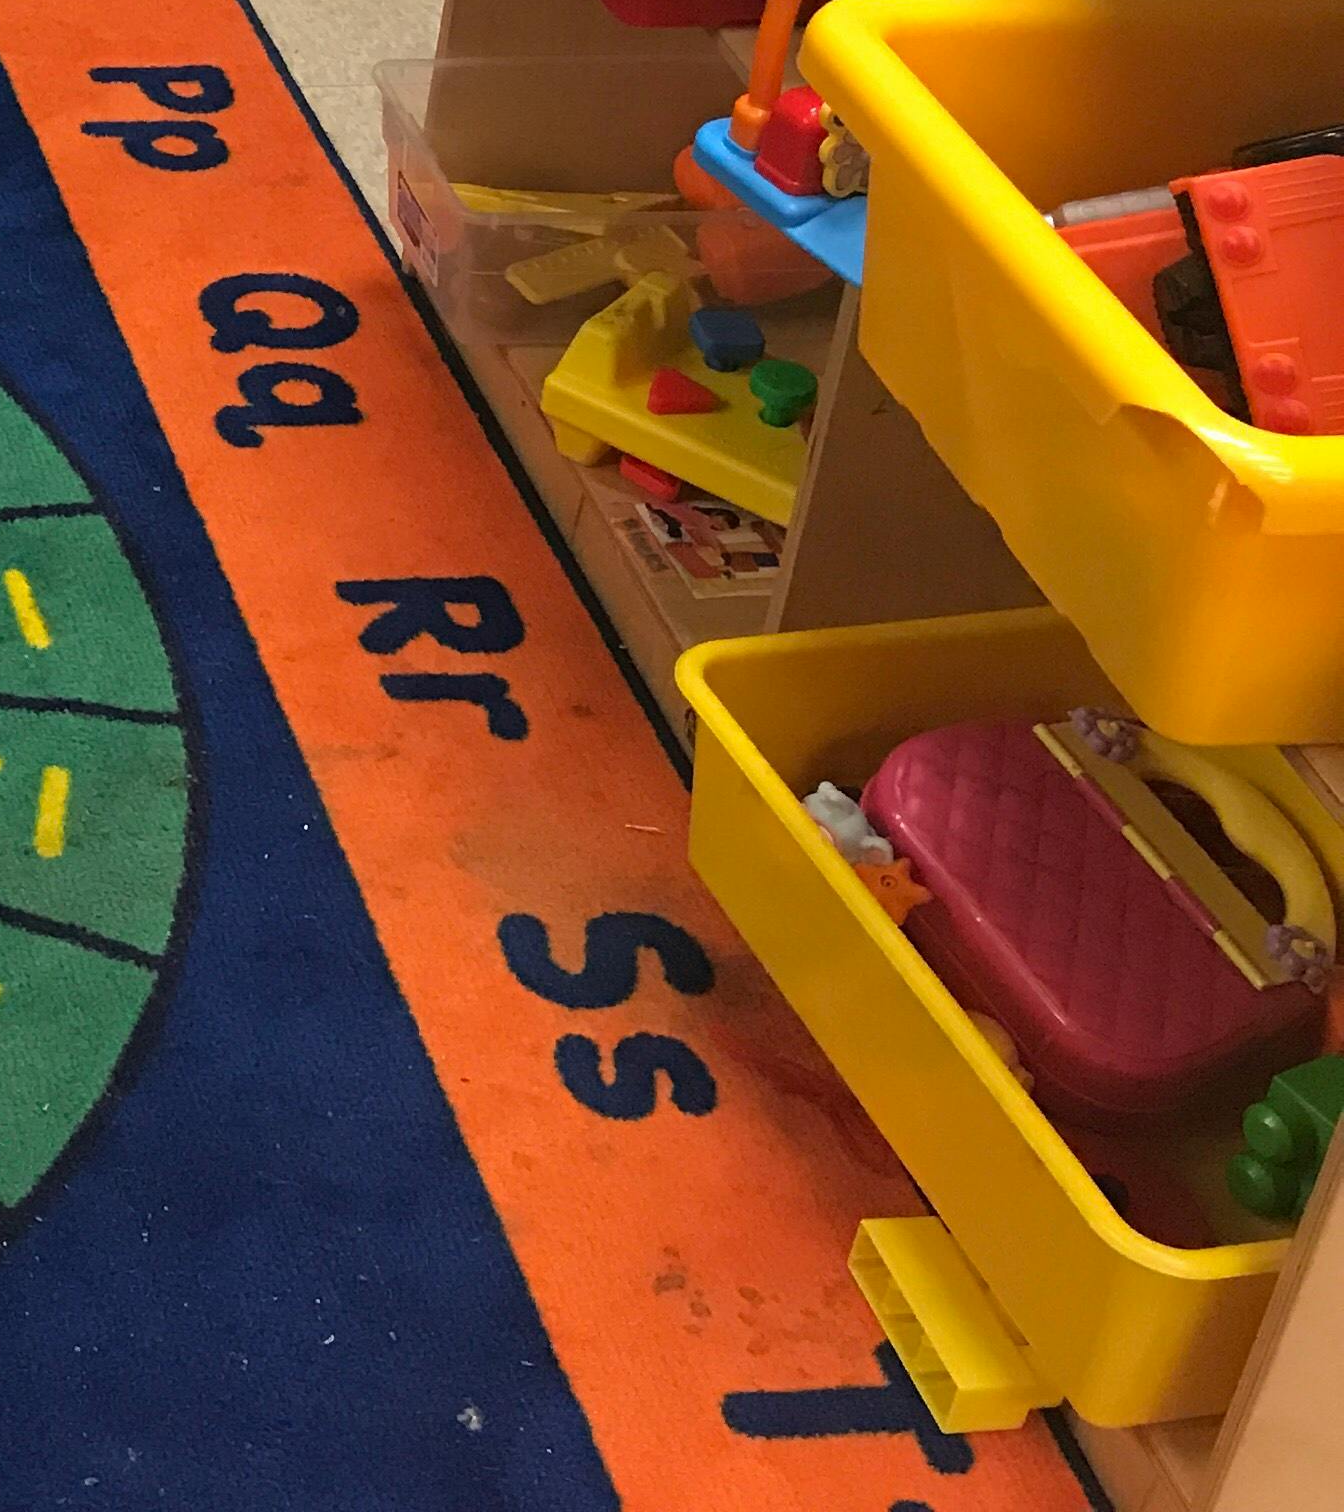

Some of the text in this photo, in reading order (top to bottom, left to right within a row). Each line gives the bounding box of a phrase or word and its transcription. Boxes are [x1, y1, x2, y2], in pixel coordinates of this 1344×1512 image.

[80, 65, 234, 171] Pp
[199, 273, 366, 448] Qq
[335, 575, 529, 741] Rr
[498, 911, 717, 1121] Ss
